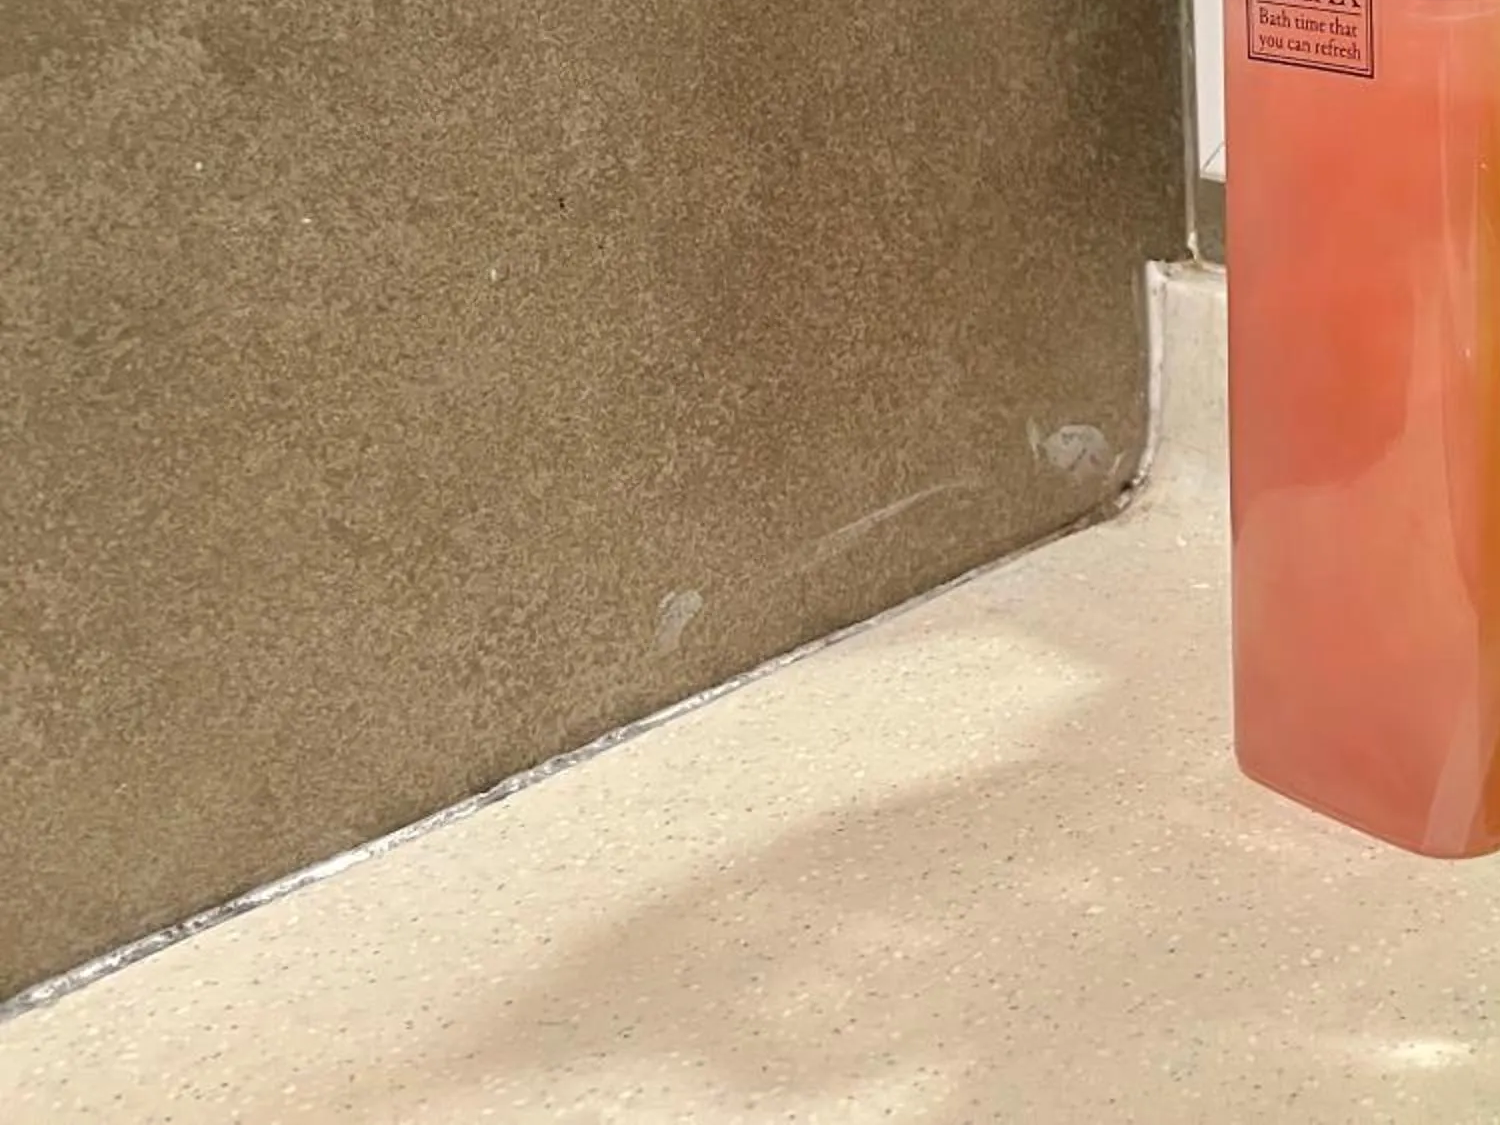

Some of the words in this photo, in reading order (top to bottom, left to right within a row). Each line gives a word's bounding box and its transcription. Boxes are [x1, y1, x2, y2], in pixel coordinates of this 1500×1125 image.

[1259, 7, 1291, 27] Bath
[1295, 15, 1325, 33] time
[1329, 16, 1358, 37] that
[1259, 35, 1284, 51] you
[1287, 40, 1312, 54] can
[1315, 39, 1361, 60] refresh
